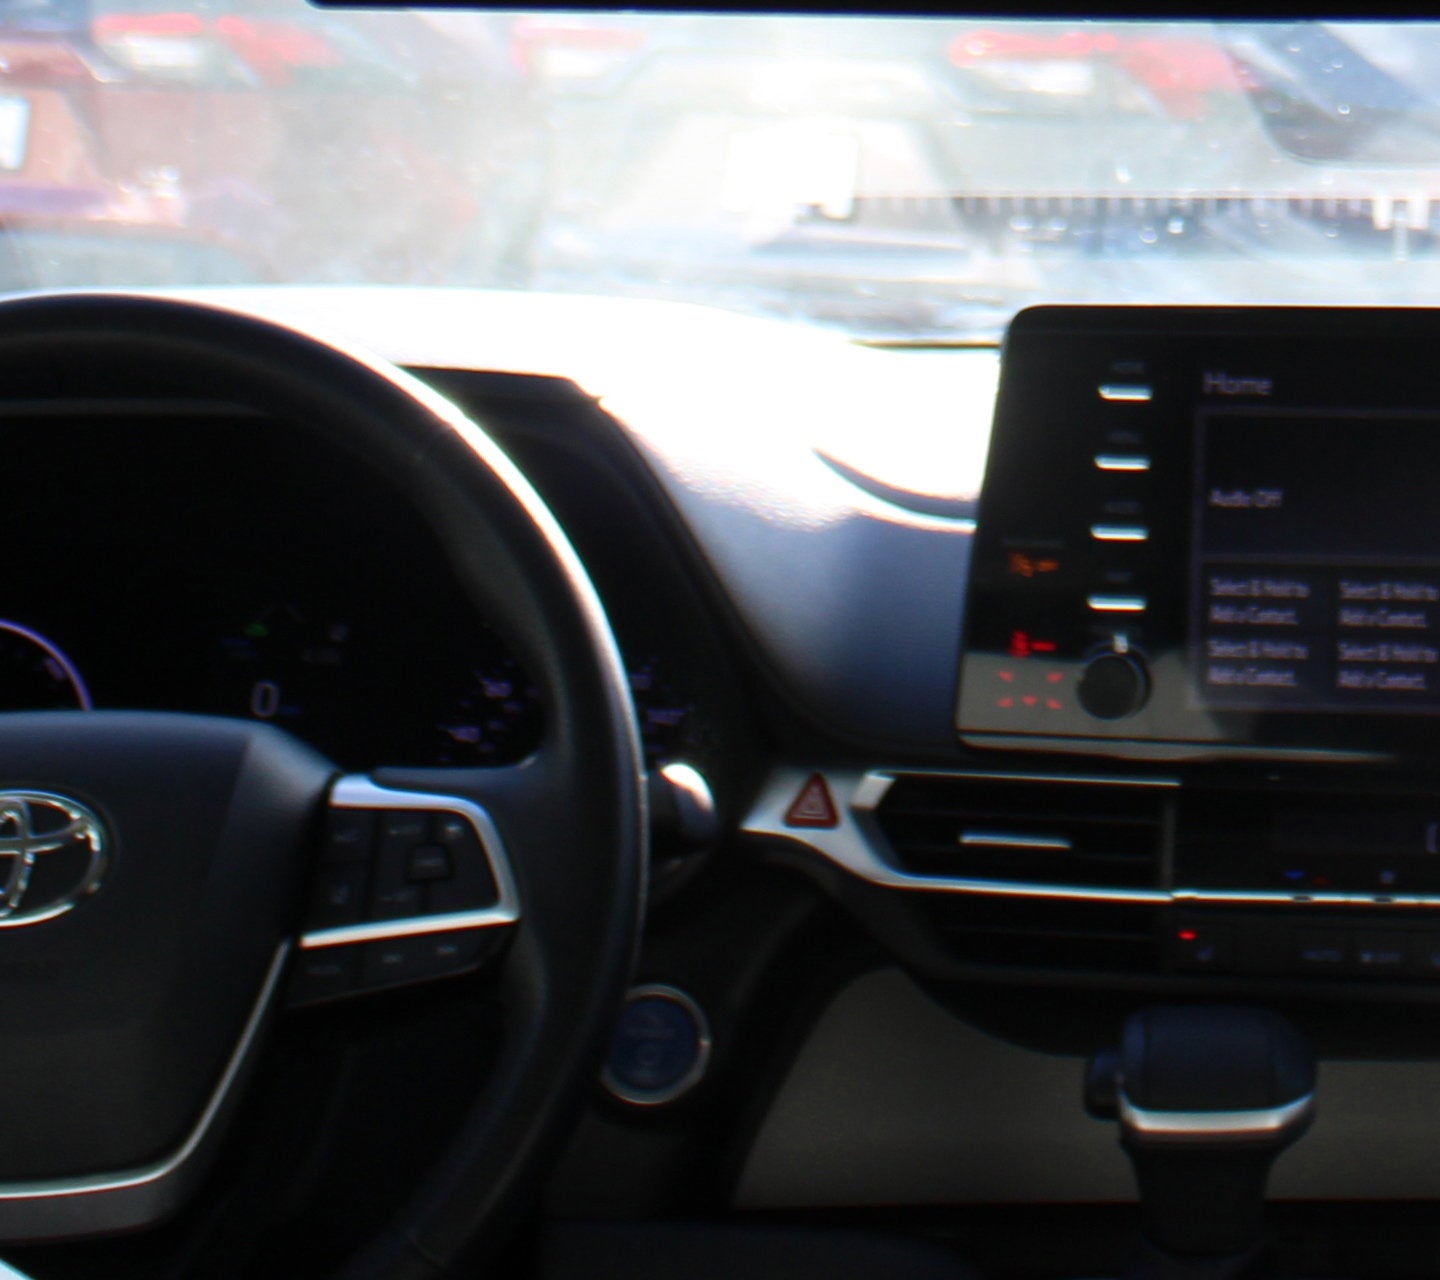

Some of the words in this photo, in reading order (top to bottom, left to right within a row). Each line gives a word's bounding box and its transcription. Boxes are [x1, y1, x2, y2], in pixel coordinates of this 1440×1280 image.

[1203, 371, 1272, 396] Home
[1210, 488, 1251, 507] Audio
[1255, 489, 1283, 507] Off
[1210, 576, 1250, 597] Select
[1338, 580, 1378, 601] Select
[1209, 638, 1249, 659] Select
[1337, 642, 1377, 663] Select
[250, 680, 280, 719] 0
